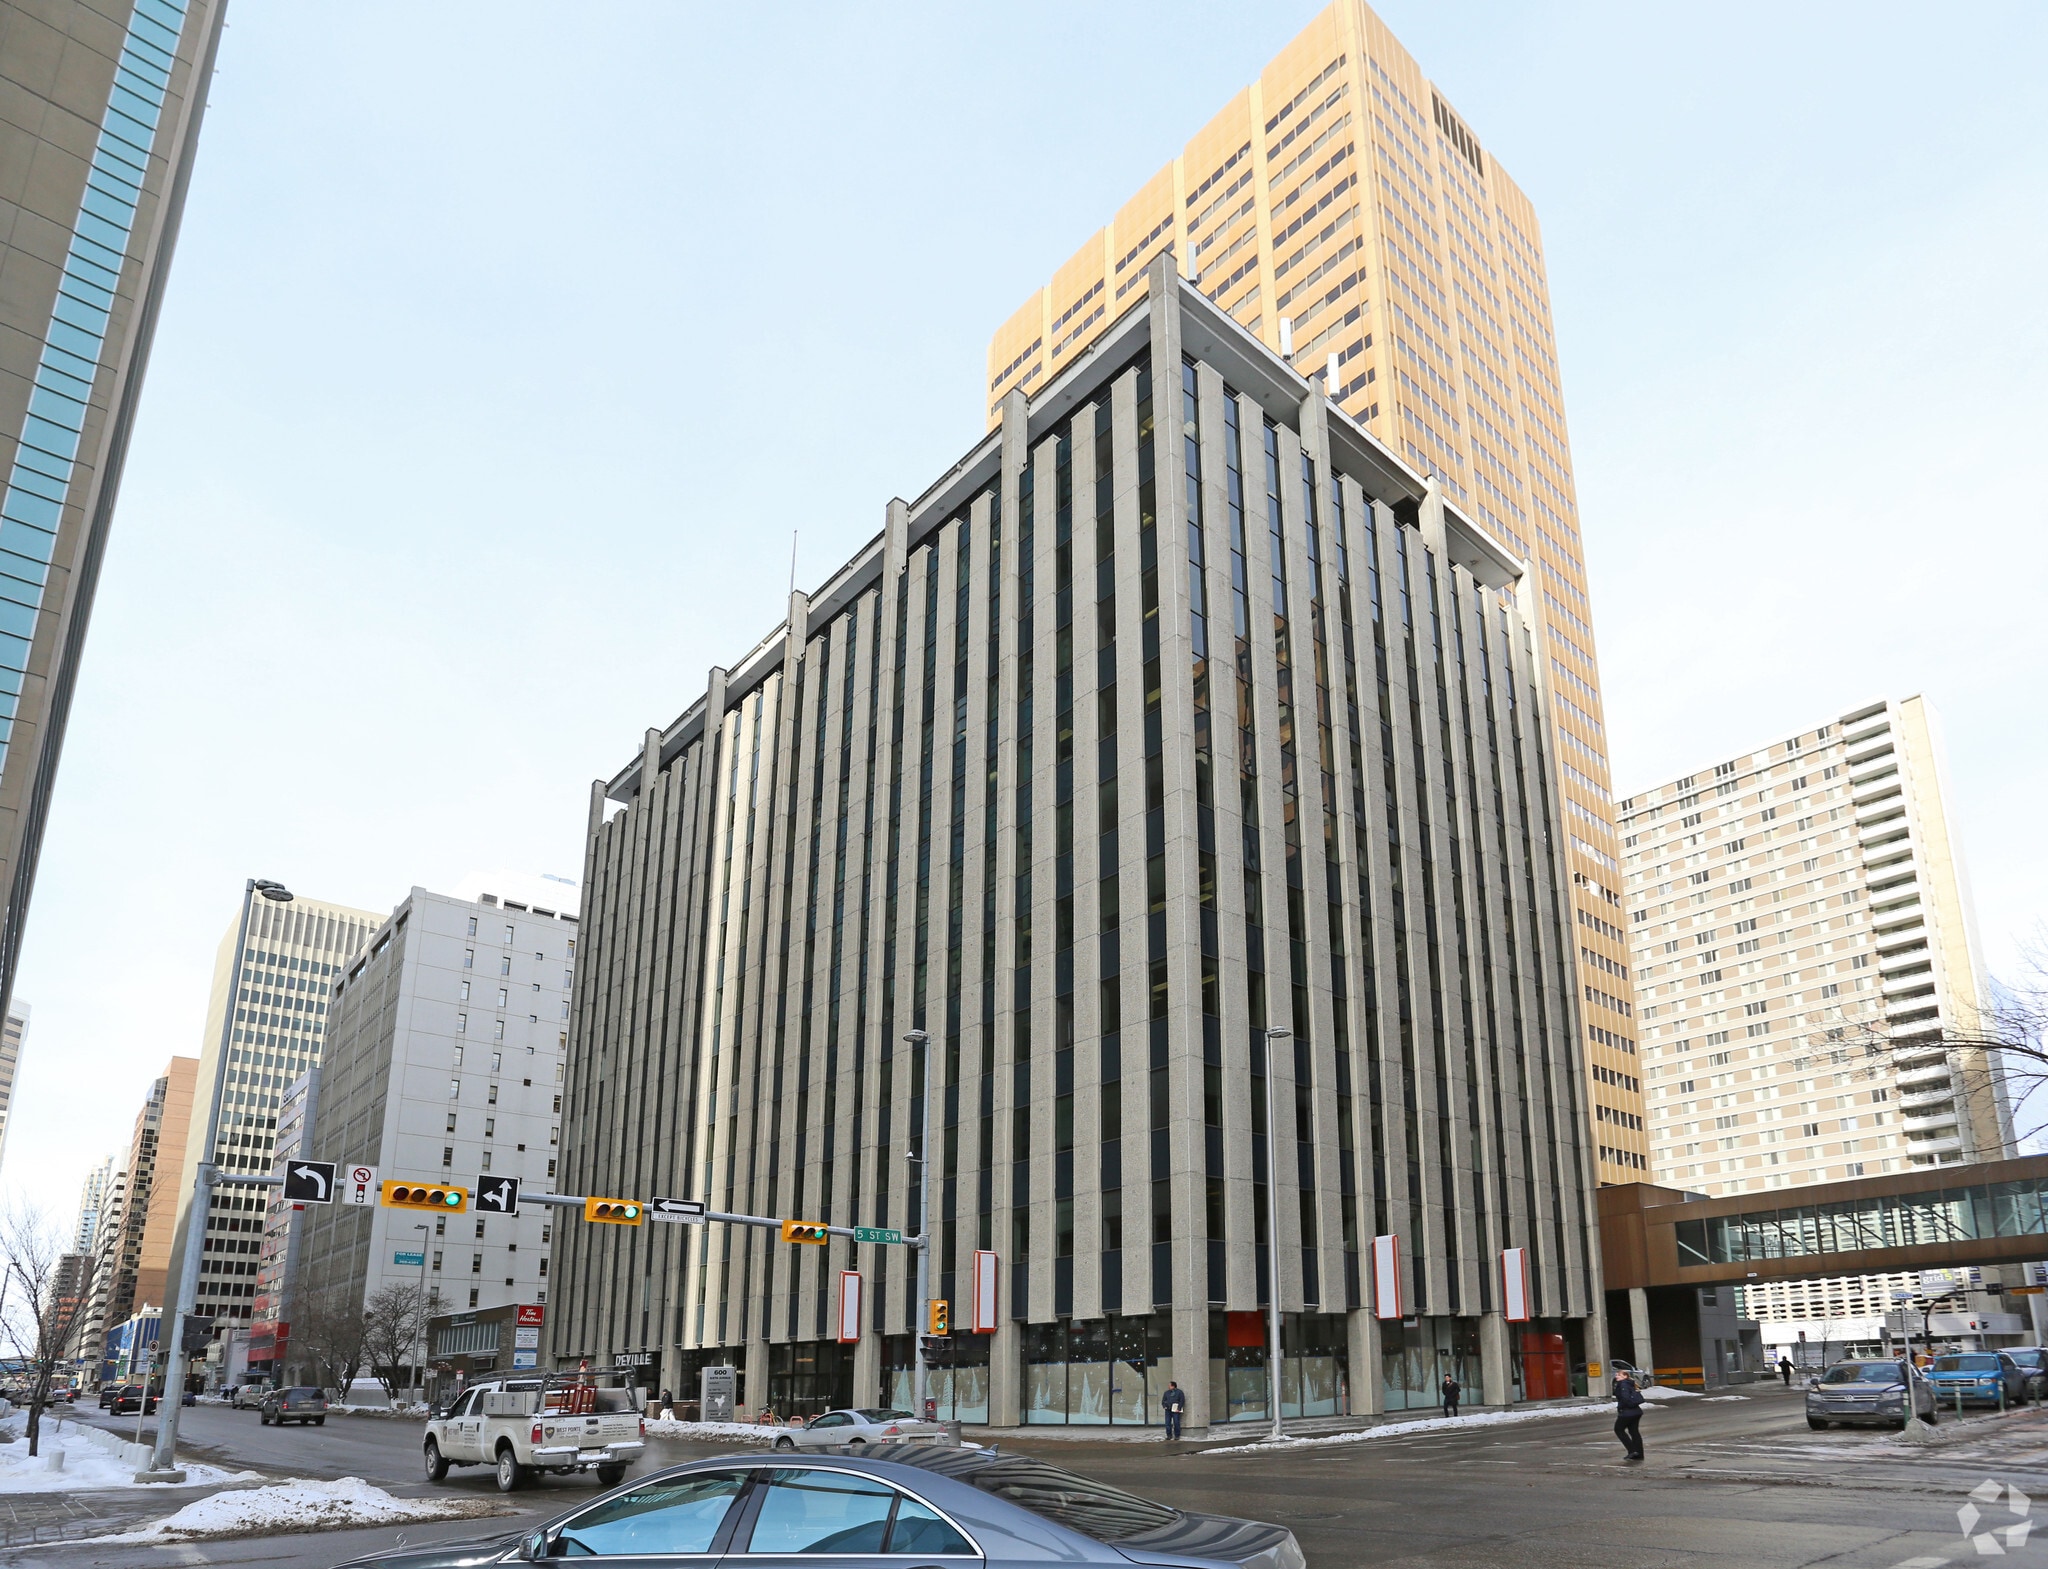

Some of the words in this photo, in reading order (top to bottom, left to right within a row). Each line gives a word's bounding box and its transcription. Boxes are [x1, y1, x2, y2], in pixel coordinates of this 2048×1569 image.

[857, 1230, 864, 1239] 5
[869, 1231, 880, 1240] ST
[885, 1232, 899, 1241] SW
[526, 1308, 537, 1316] Tim
[519, 1315, 541, 1323] Hortons
[615, 1353, 652, 1366] DEVILLE
